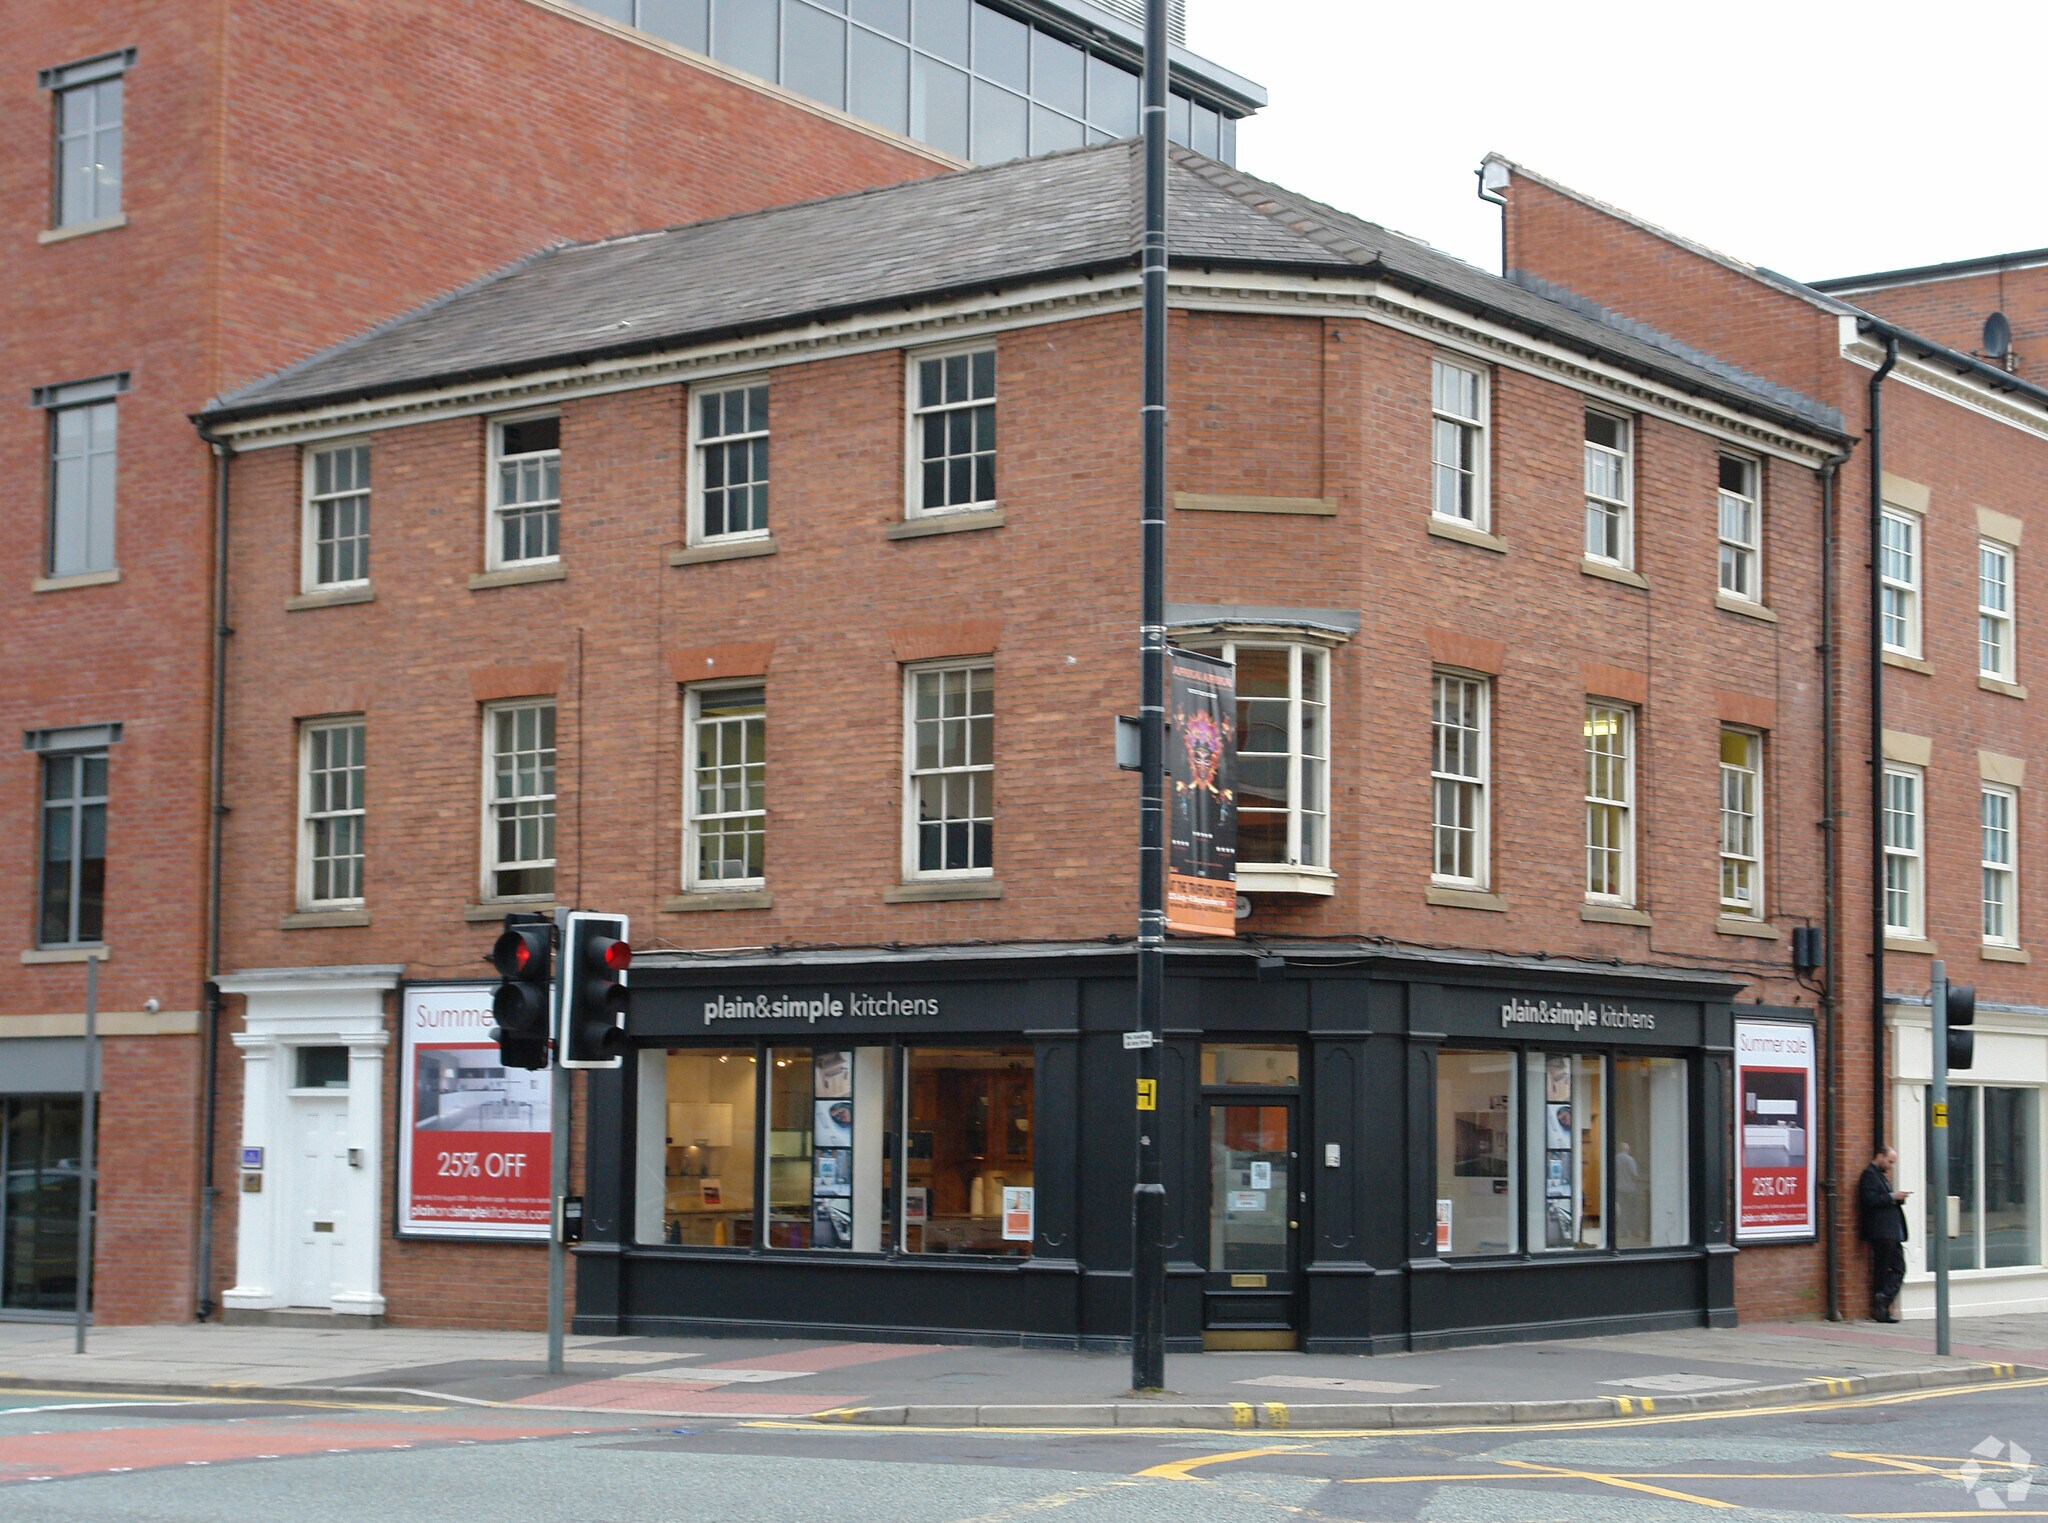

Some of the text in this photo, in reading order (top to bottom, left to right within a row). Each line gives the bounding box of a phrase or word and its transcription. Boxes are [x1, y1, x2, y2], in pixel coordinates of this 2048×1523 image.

[416, 1004, 494, 1028] Summe
[703, 991, 939, 1025] plain&simple kitchens
[1501, 998, 1656, 1031] plain&simple kitchens
[1740, 1033, 1807, 1053] Summer sale
[437, 1151, 527, 1178] 25% OFF
[1752, 1176, 1798, 1197] 25% OFF
